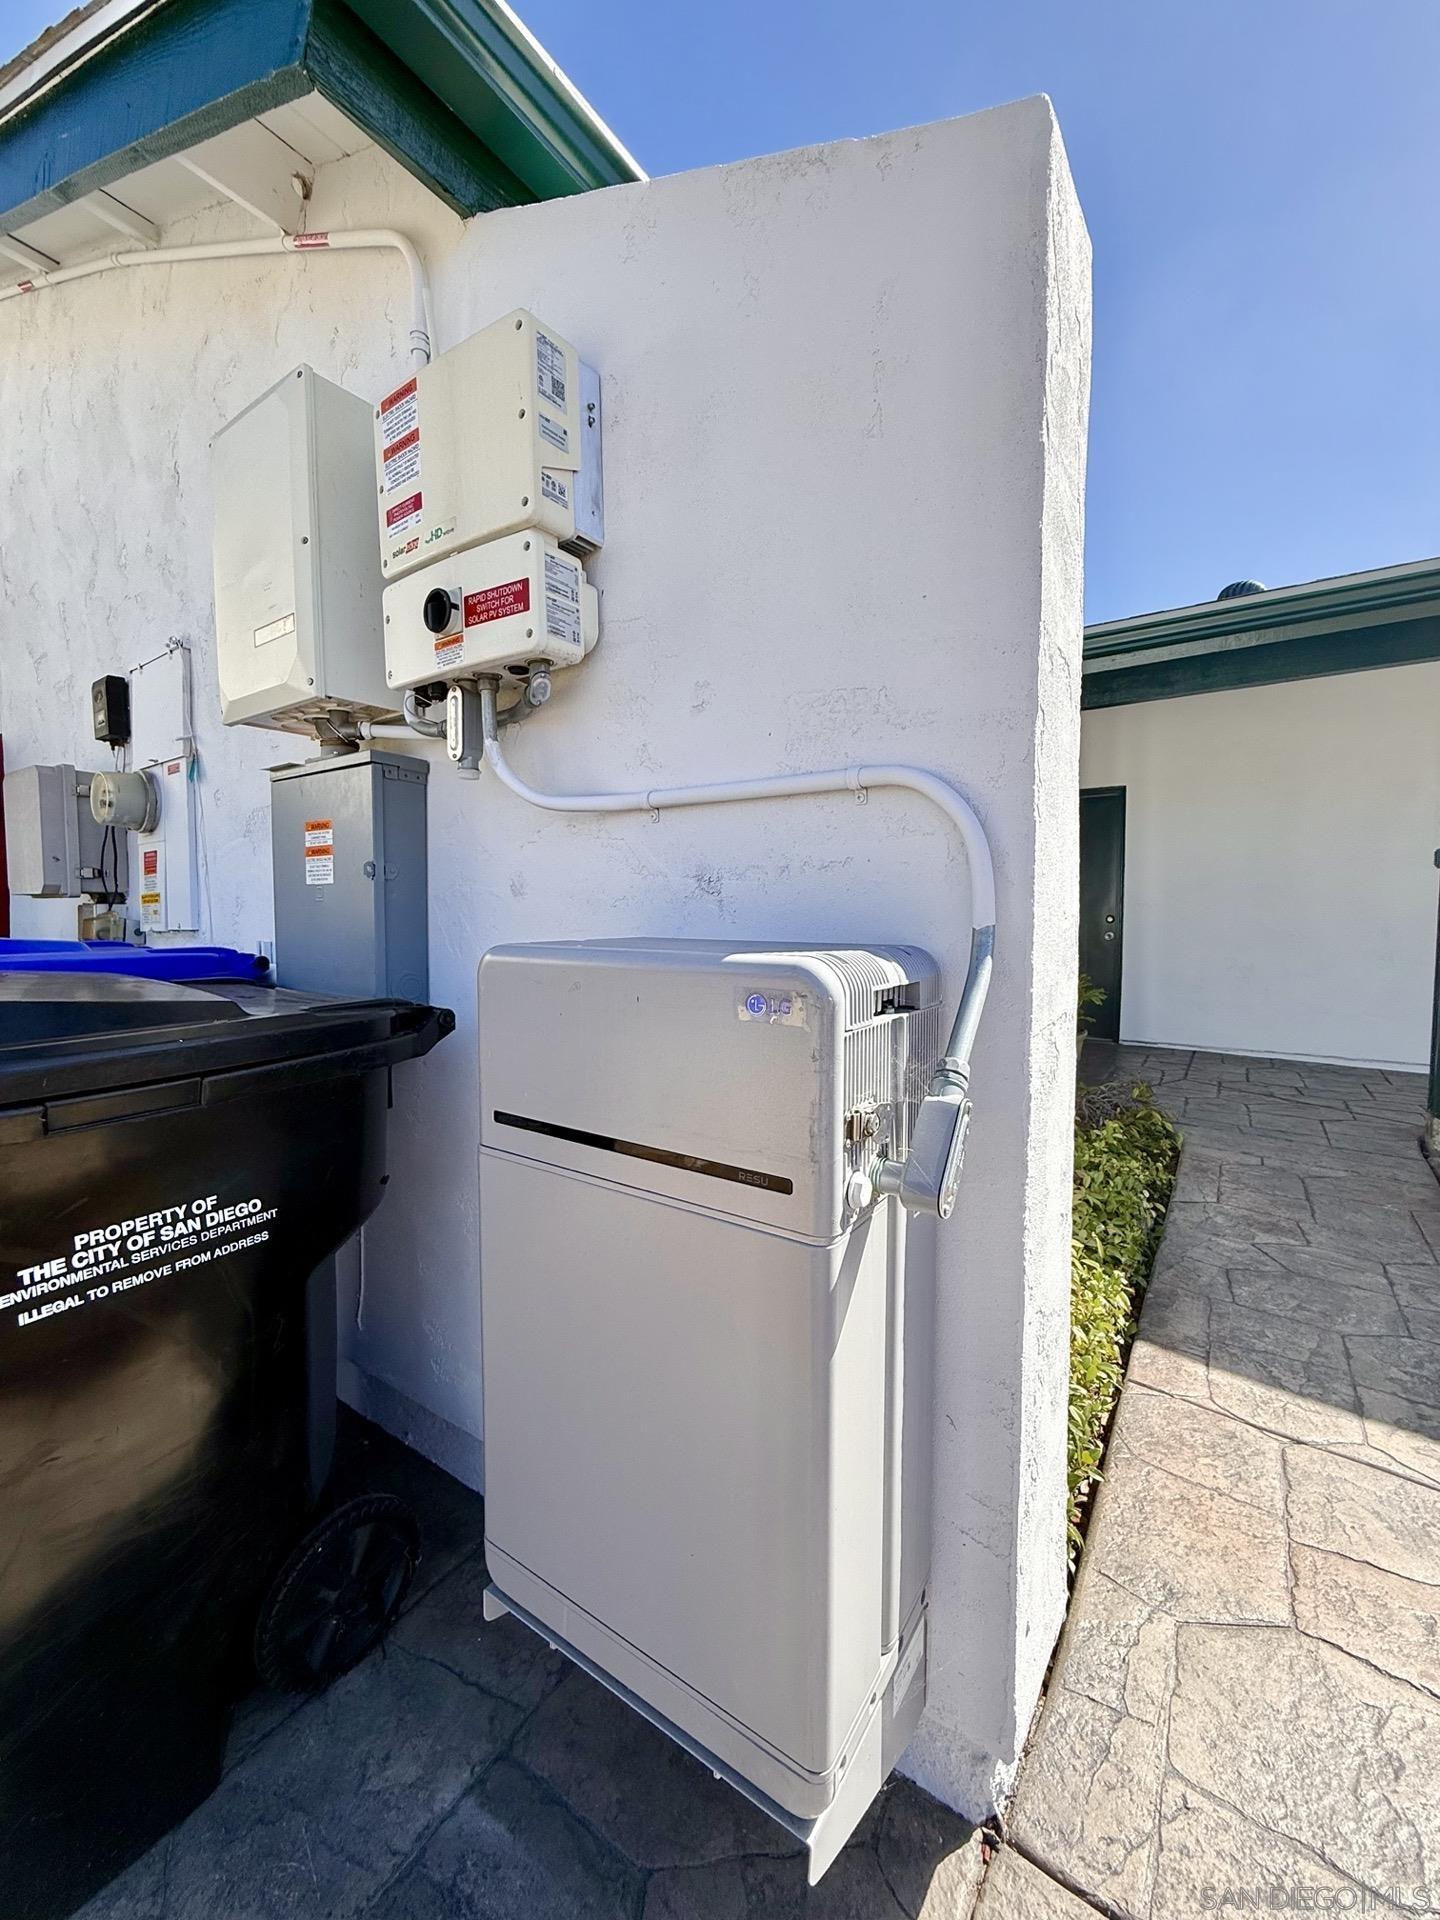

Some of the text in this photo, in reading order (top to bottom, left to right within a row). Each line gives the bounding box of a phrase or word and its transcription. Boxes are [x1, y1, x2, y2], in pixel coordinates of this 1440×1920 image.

[468, 582, 523, 606] RAPID SHUTDOWN
[468, 602, 524, 625] SOLAR PV SYSTEM
[476, 595, 514, 613] SWITCH FOR
[738, 1171, 769, 1186] RESU
[74, 1195, 218, 1250] PROPERTY OF
[0, 1208, 279, 1310] ENVIRONMENTAL SERVICES DEPARTMENT
[17, 1199, 262, 1286] THE CITY OF SAN DIEGO
[17, 1231, 270, 1327] ILLEGAL TO REMOVE FROM ADDRESS
